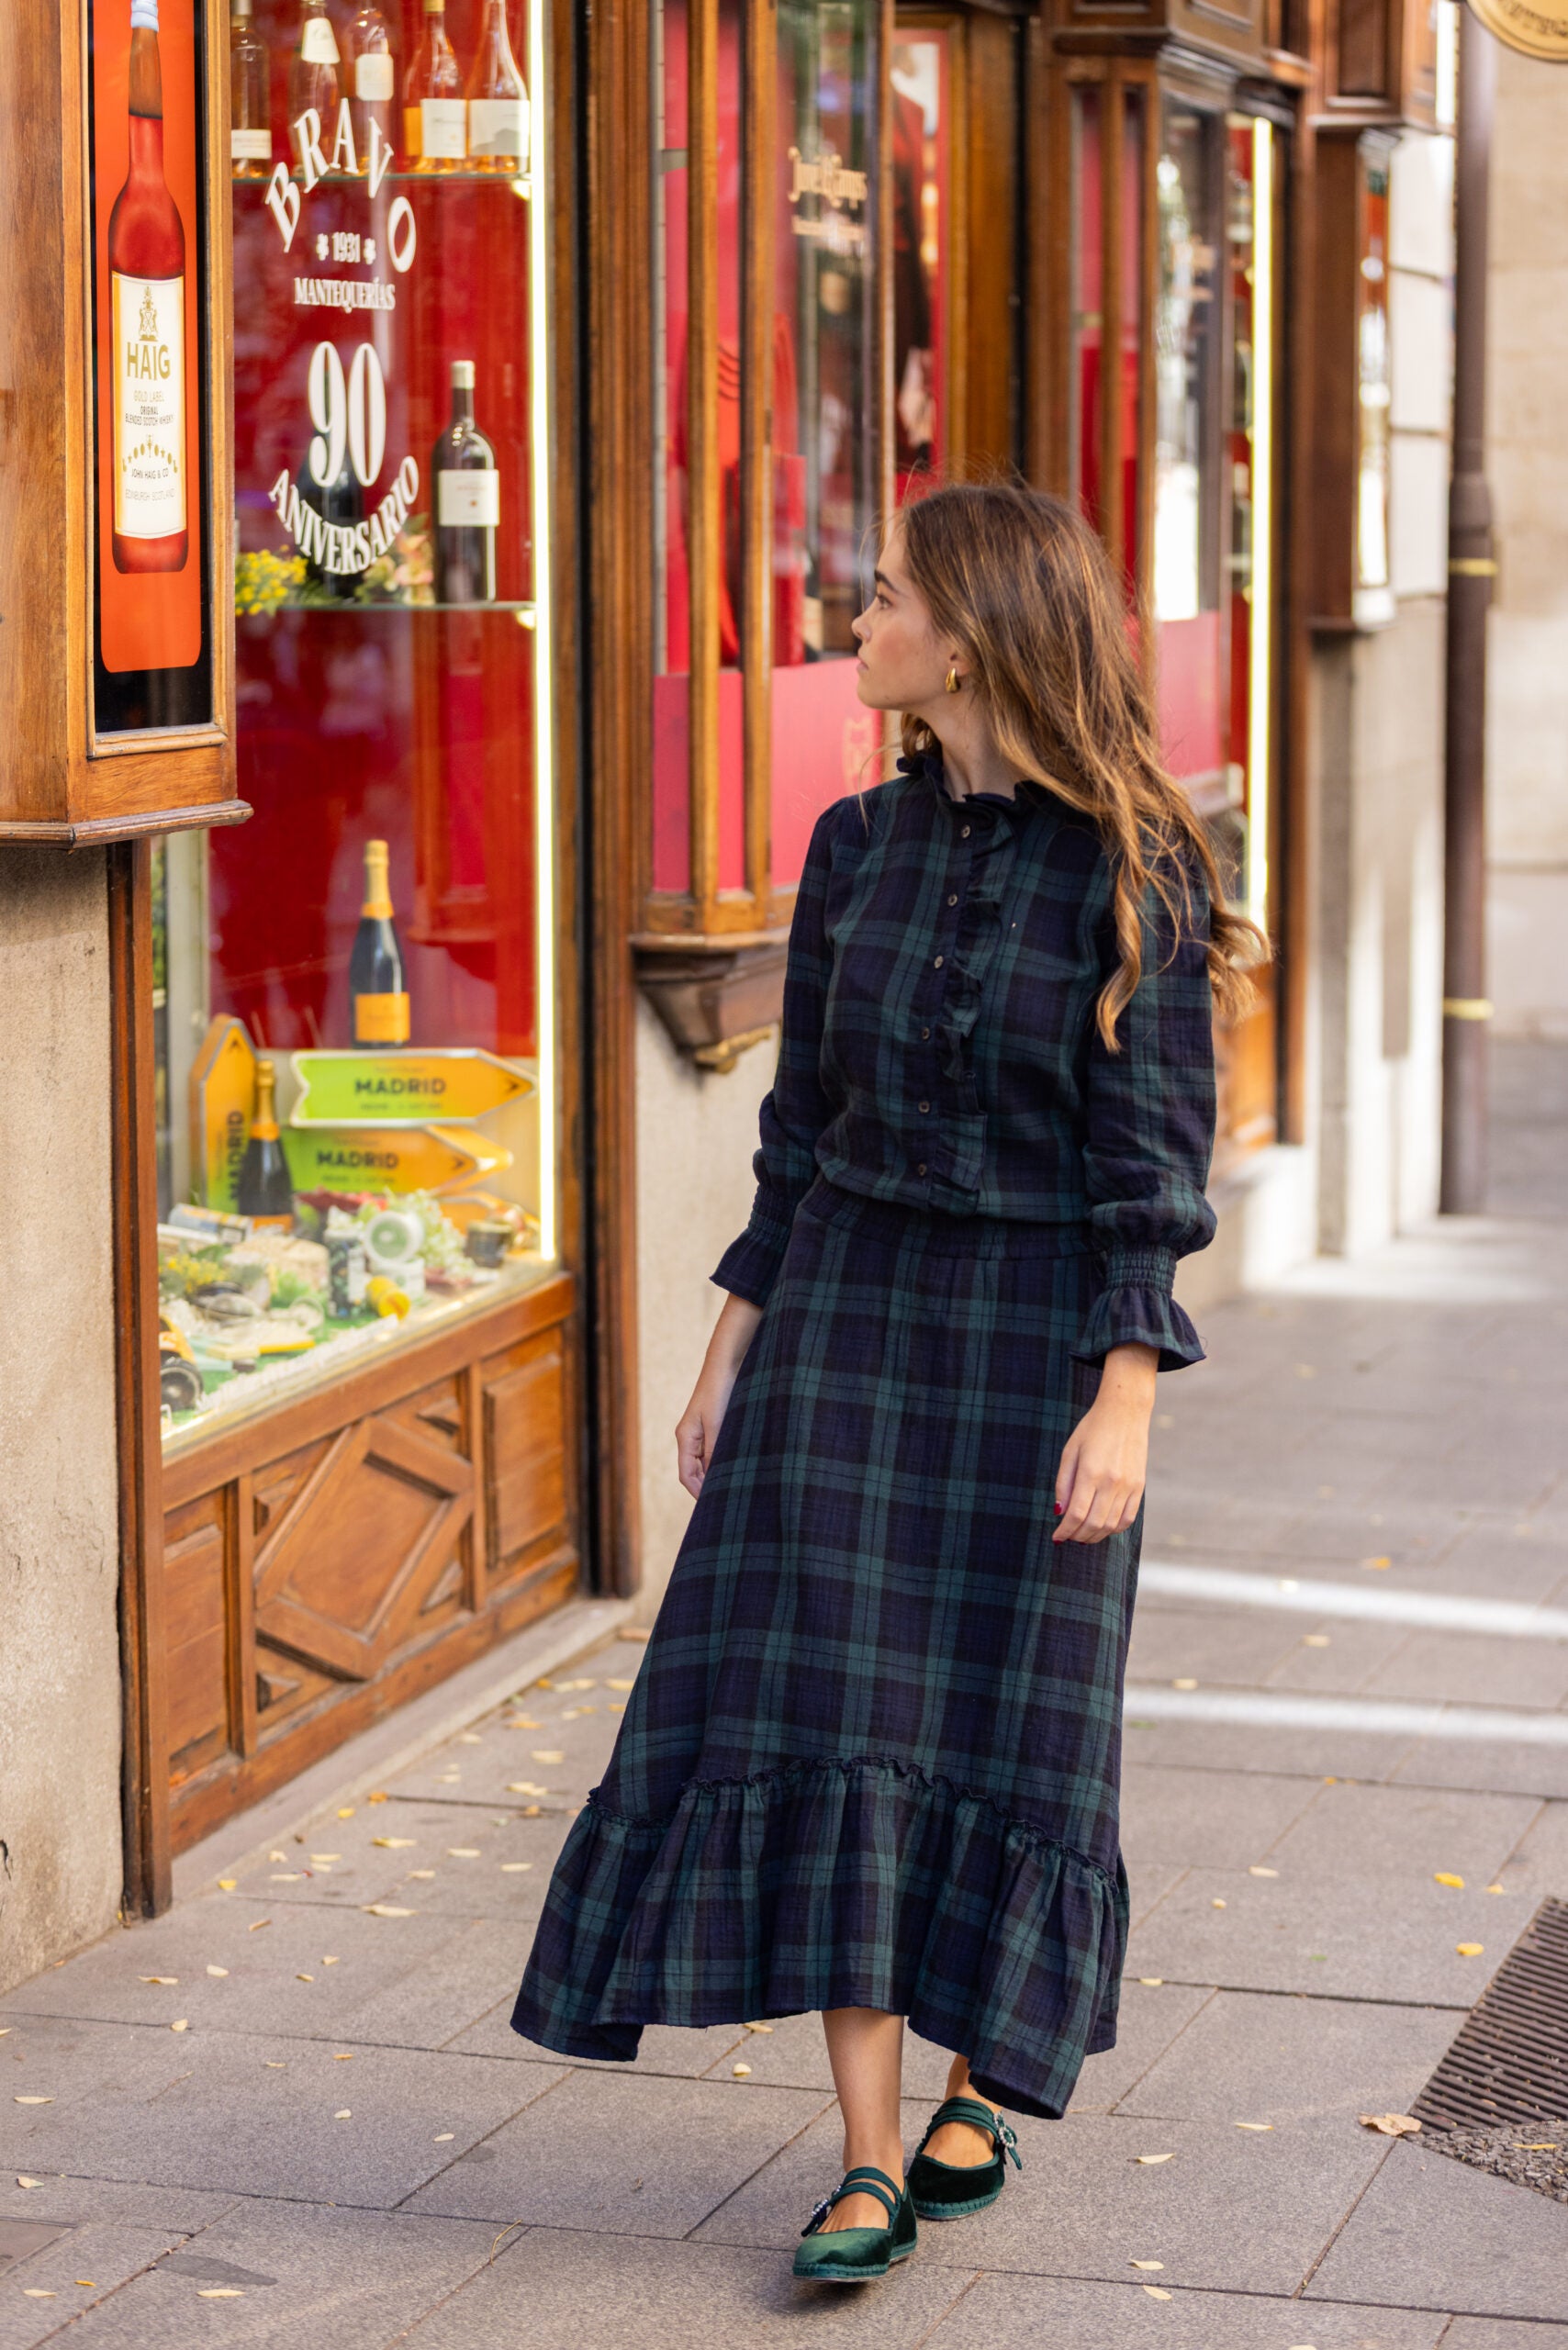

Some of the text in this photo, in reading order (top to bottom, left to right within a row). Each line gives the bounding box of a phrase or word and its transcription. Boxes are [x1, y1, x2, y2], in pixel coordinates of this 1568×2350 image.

[264, 97, 417, 274] BRAVO
[331, 231, 361, 263] 1931
[294, 276, 396, 314] MANTEQUERÍAS
[127, 341, 171, 381] HAIG
[308, 341, 386, 487] 90
[131, 467, 143, 478] JOHN
[144, 470, 156, 479] HAIG
[267, 455, 420, 576] ANIVERSARIO
[354, 1077, 447, 1096] MADRID
[317, 1149, 399, 1169] MADRID
